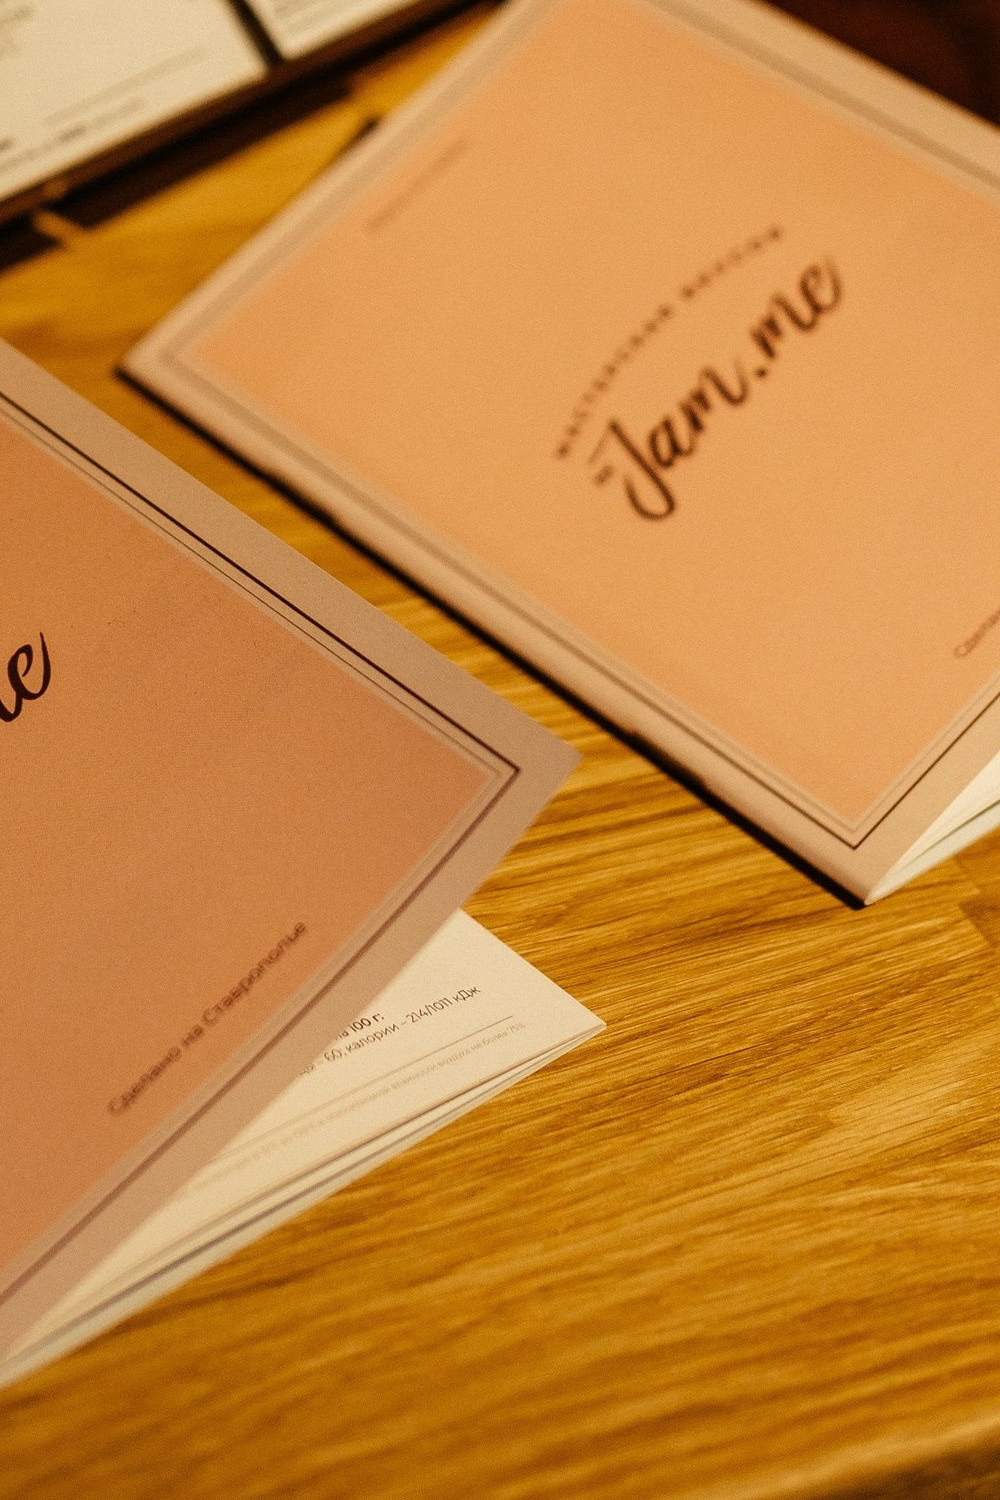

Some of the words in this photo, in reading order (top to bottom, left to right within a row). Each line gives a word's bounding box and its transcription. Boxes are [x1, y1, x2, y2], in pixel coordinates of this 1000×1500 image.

[586, 254, 844, 522] Jam.me
[201, 920, 308, 1026] Ставрополье
[347, 1023, 400, 1055] калории
[405, 996, 454, 1024] 214/1011
[452, 985, 482, 1005] кДж
[350, 1016, 372, 1034] 100
